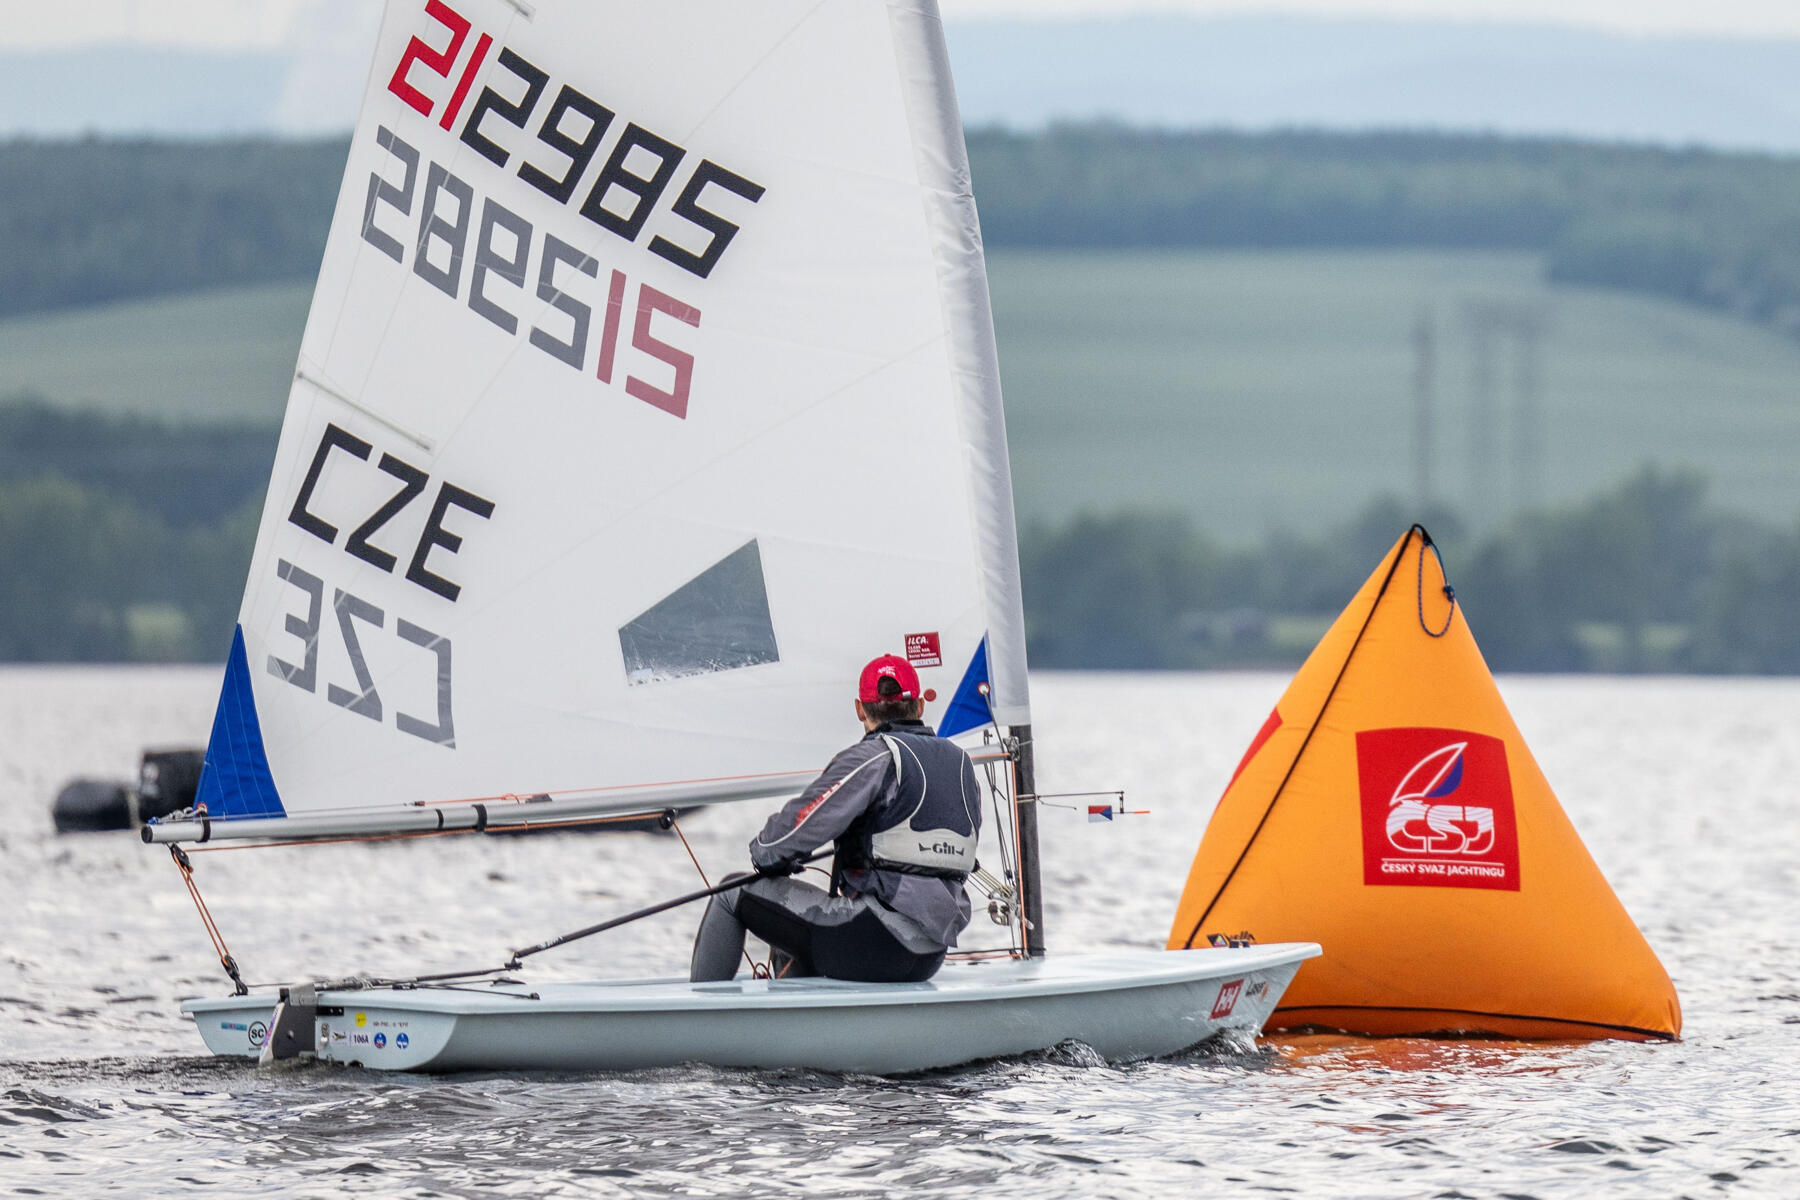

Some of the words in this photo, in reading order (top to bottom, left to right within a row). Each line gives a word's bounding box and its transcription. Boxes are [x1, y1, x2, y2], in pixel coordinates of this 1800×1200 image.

[388, 0, 766, 279] 212985
[288, 422, 495, 603] CZE
[932, 842, 955, 855] Gill
[1381, 861, 1415, 873] ČESKÝ
[1418, 863, 1445, 875] SVAZ
[1447, 864, 1505, 877] JACHTINGU
[251, 1028, 265, 1039] SC
[354, 1034, 369, 1044] 106A
